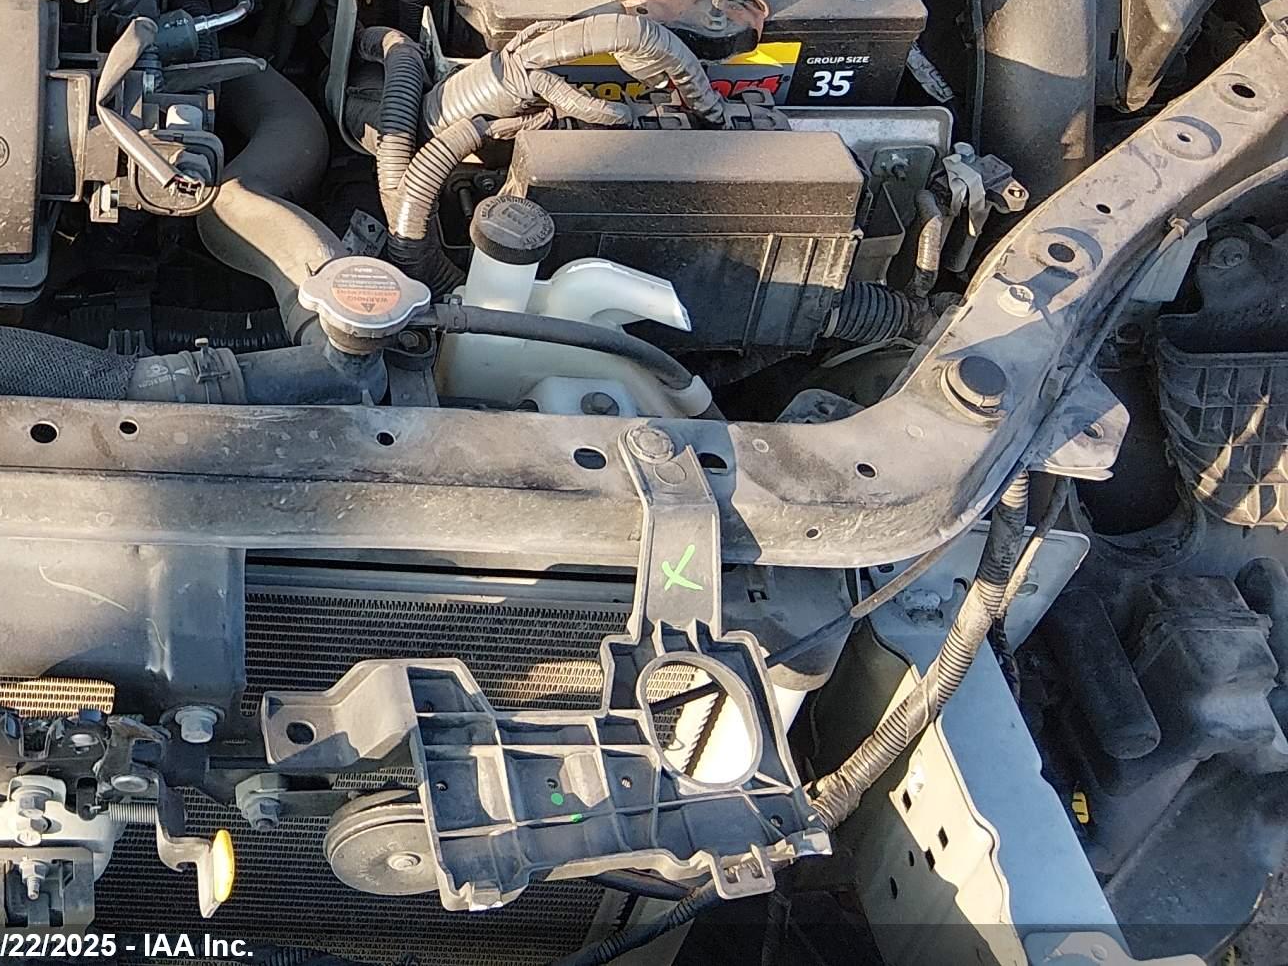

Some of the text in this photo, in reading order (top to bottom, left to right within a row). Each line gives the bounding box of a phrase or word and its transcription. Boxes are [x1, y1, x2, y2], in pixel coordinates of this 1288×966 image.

[806, 55, 870, 65] GROUP SIZE
[808, 70, 854, 97] 35
